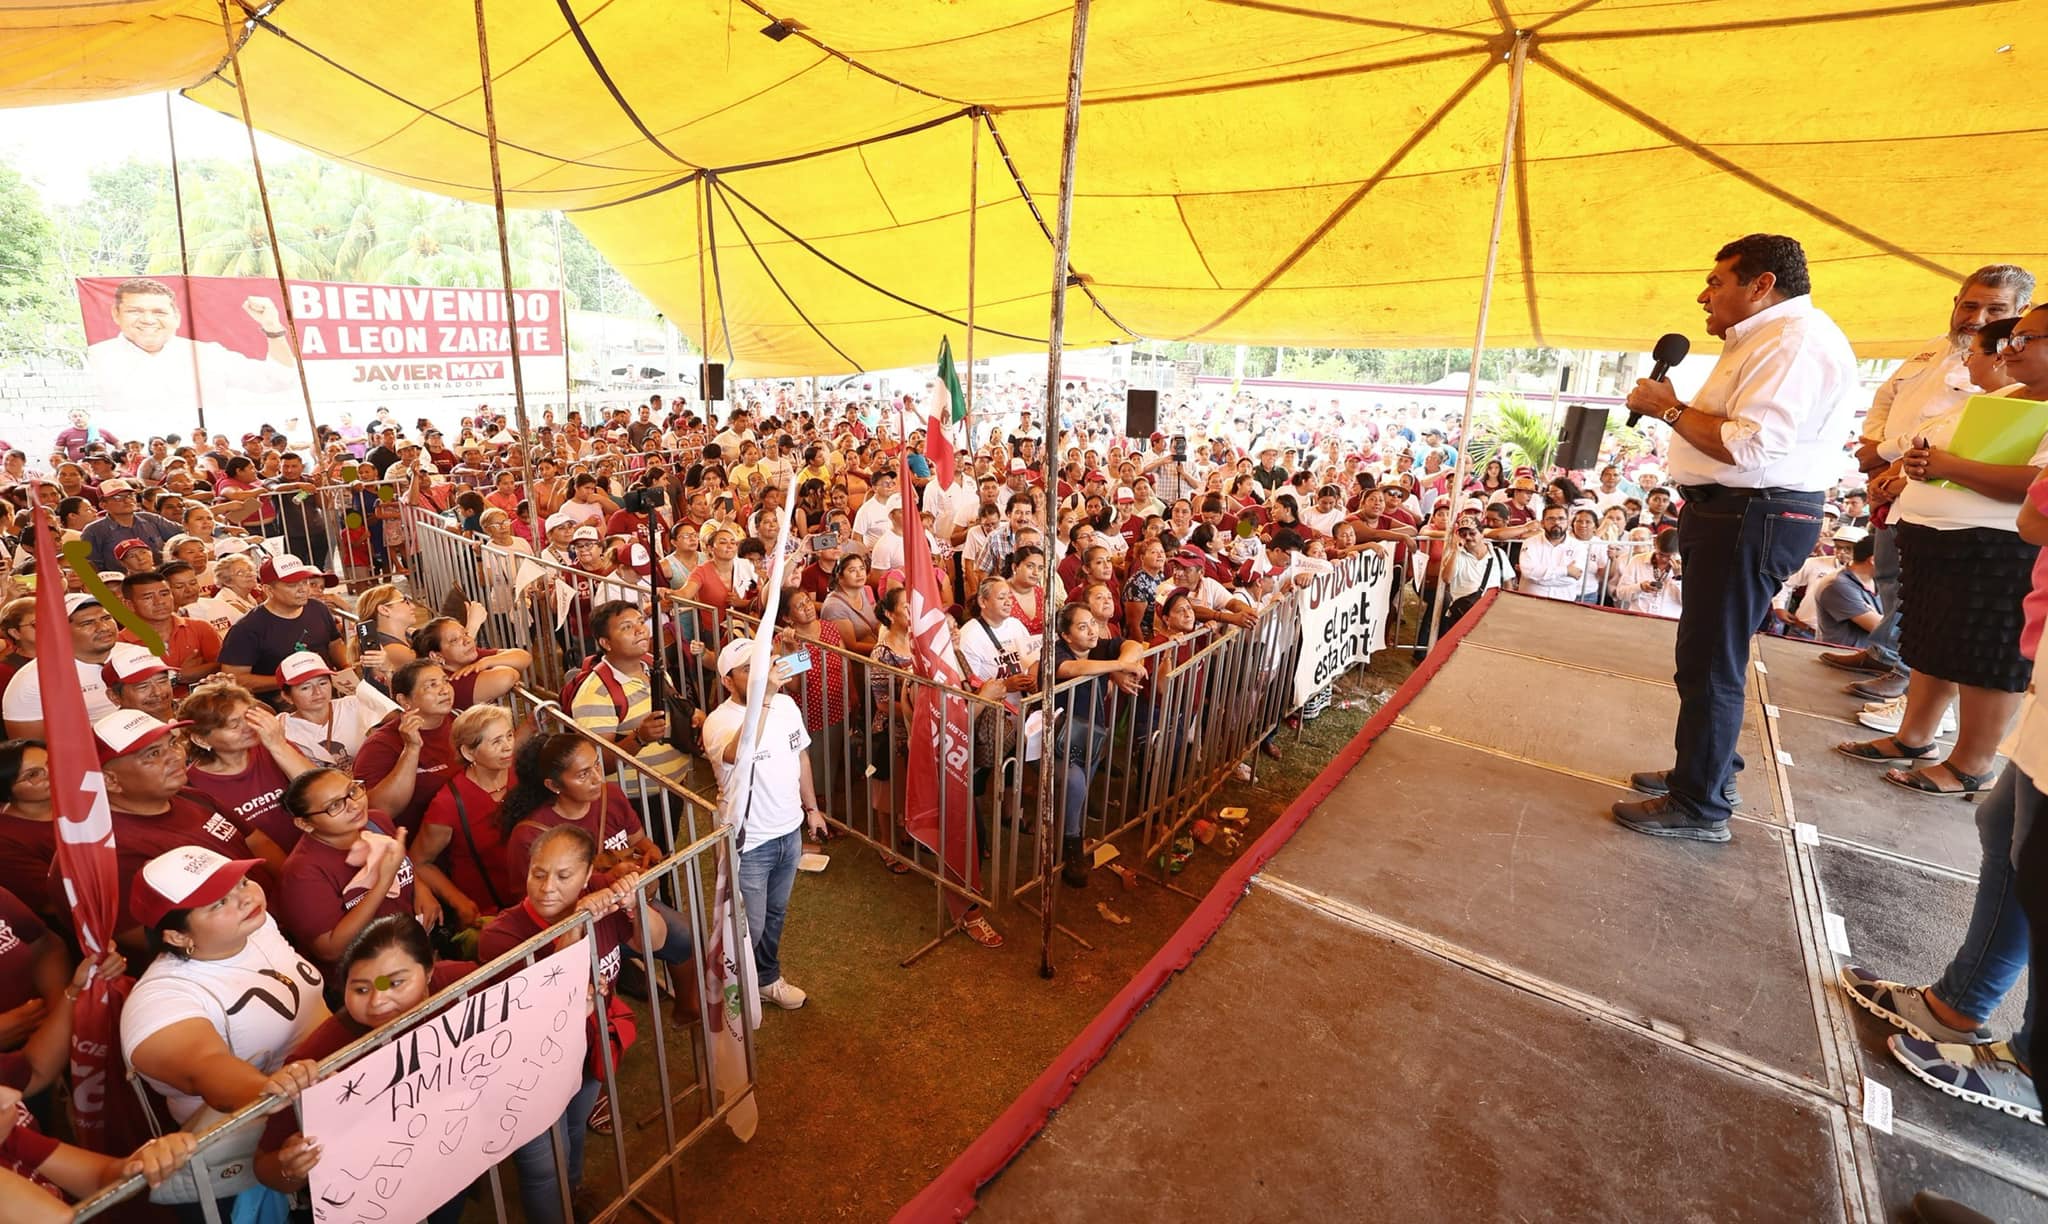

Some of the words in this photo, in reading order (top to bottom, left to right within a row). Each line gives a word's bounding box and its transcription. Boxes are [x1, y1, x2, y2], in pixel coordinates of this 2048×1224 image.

[289, 284, 550, 322] BIENVENIDO
[301, 325, 328, 355] A
[337, 325, 428, 354] LEON
[438, 326, 551, 353] ZARATE
[352, 363, 444, 383] JAVIER
[450, 362, 499, 379] MAY
[380, 380, 483, 391] GOBERNADOR
[366, 976, 532, 1105] JAVIER
[393, 1029, 513, 1121] AMIGO
